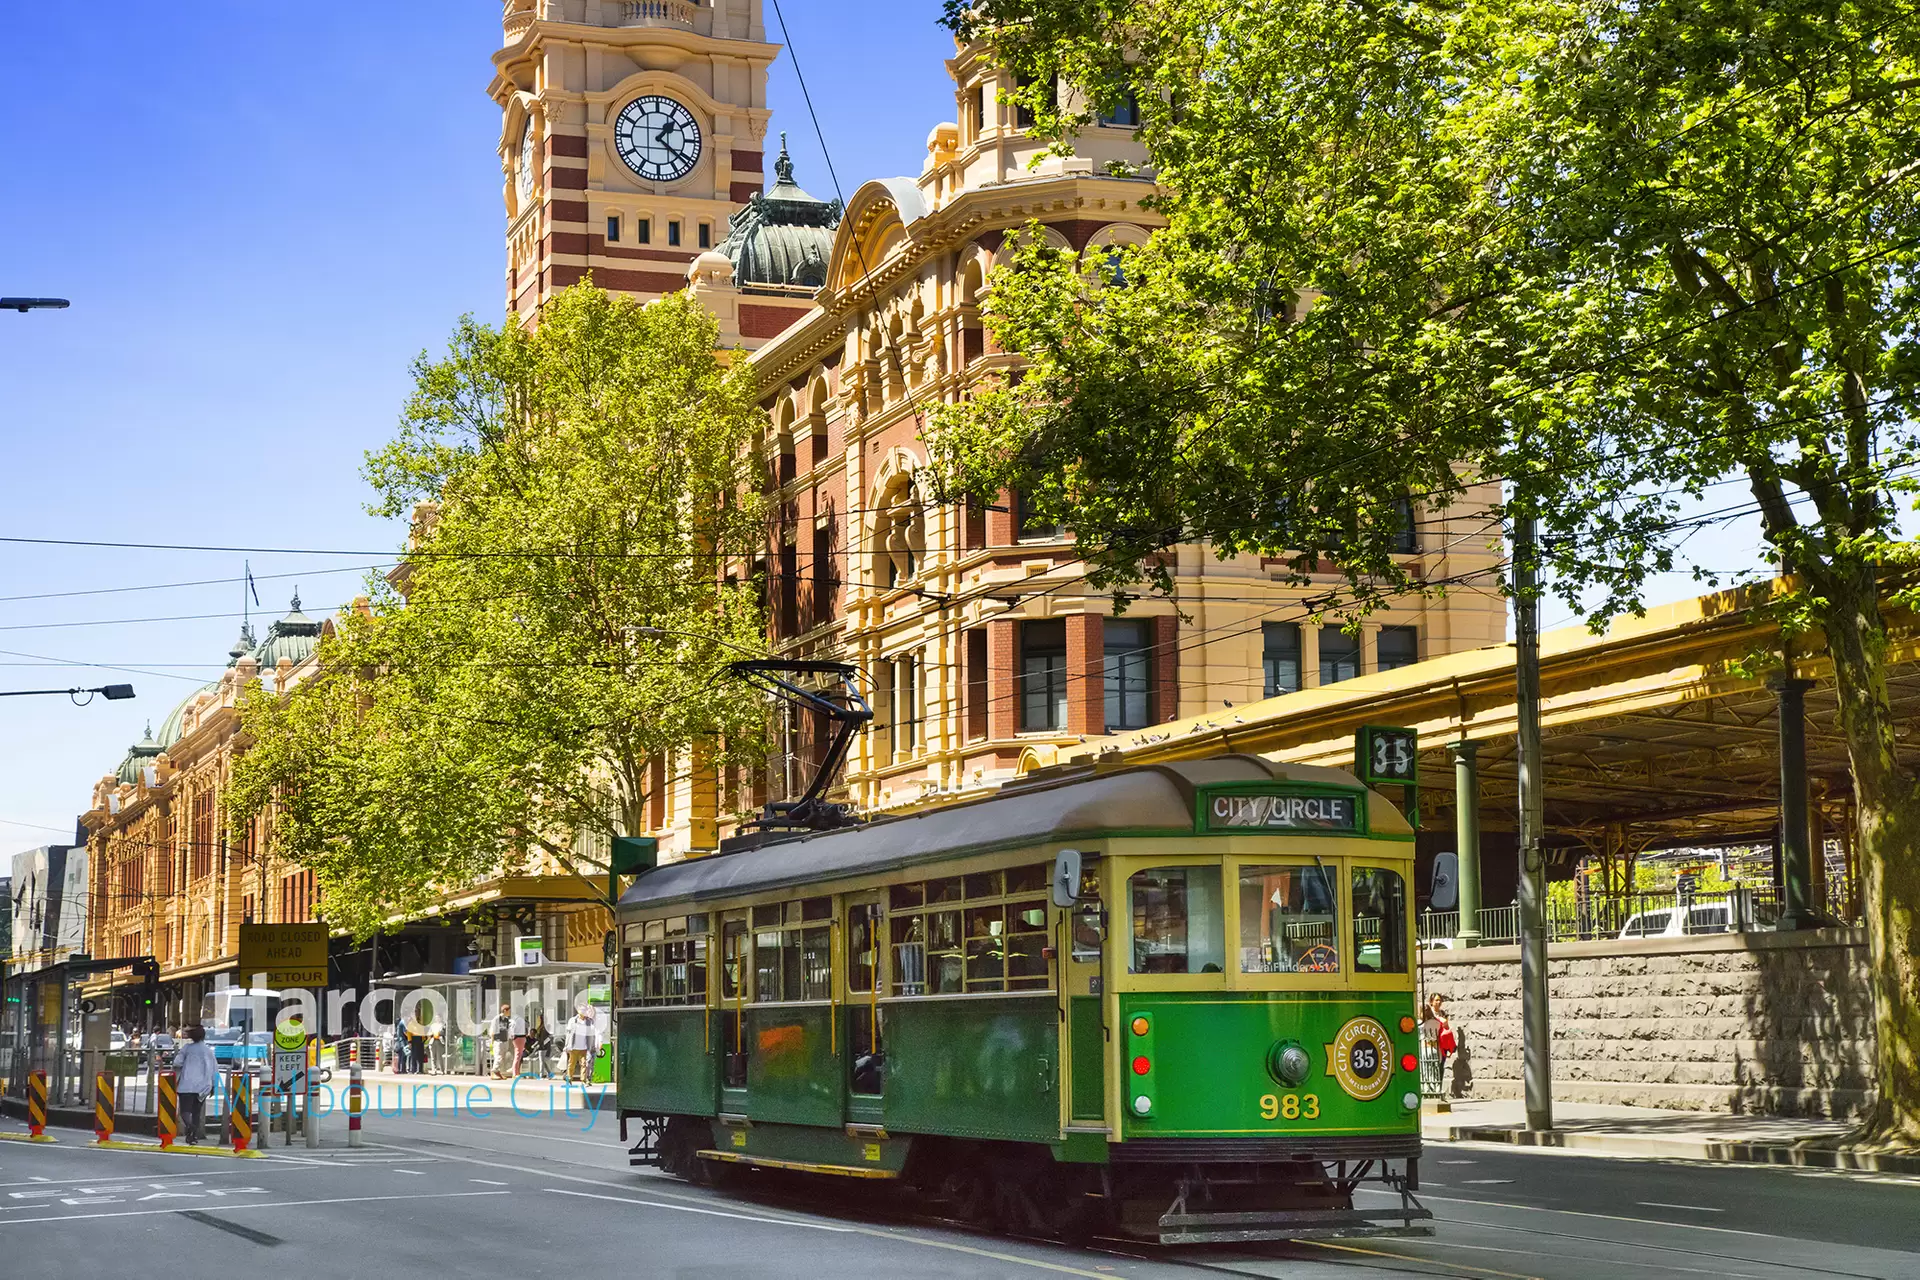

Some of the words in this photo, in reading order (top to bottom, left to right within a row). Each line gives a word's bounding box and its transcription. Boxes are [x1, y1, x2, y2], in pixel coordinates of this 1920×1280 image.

[1373, 737, 1407, 774] 35
[1213, 797, 1262, 818] CITY
[1271, 798, 1343, 820] CIRCLE
[247, 931, 276, 943] ROAD
[281, 931, 321, 943] CLOSED
[266, 947, 302, 959] AHEAD
[265, 971, 323, 983] DETOUR
[281, 1036, 300, 1044] ZONE
[1338, 1042, 1348, 1072] CITY
[1345, 1024, 1377, 1042] CIRCLE
[1376, 1033, 1389, 1071] TRAM
[280, 1054, 302, 1063] KEEP
[1353, 1048, 1375, 1069] 35
[280, 1063, 300, 1072] LEFT
[1349, 1077, 1381, 1091] MELBOURNE
[1260, 1093, 1320, 1120] 983
